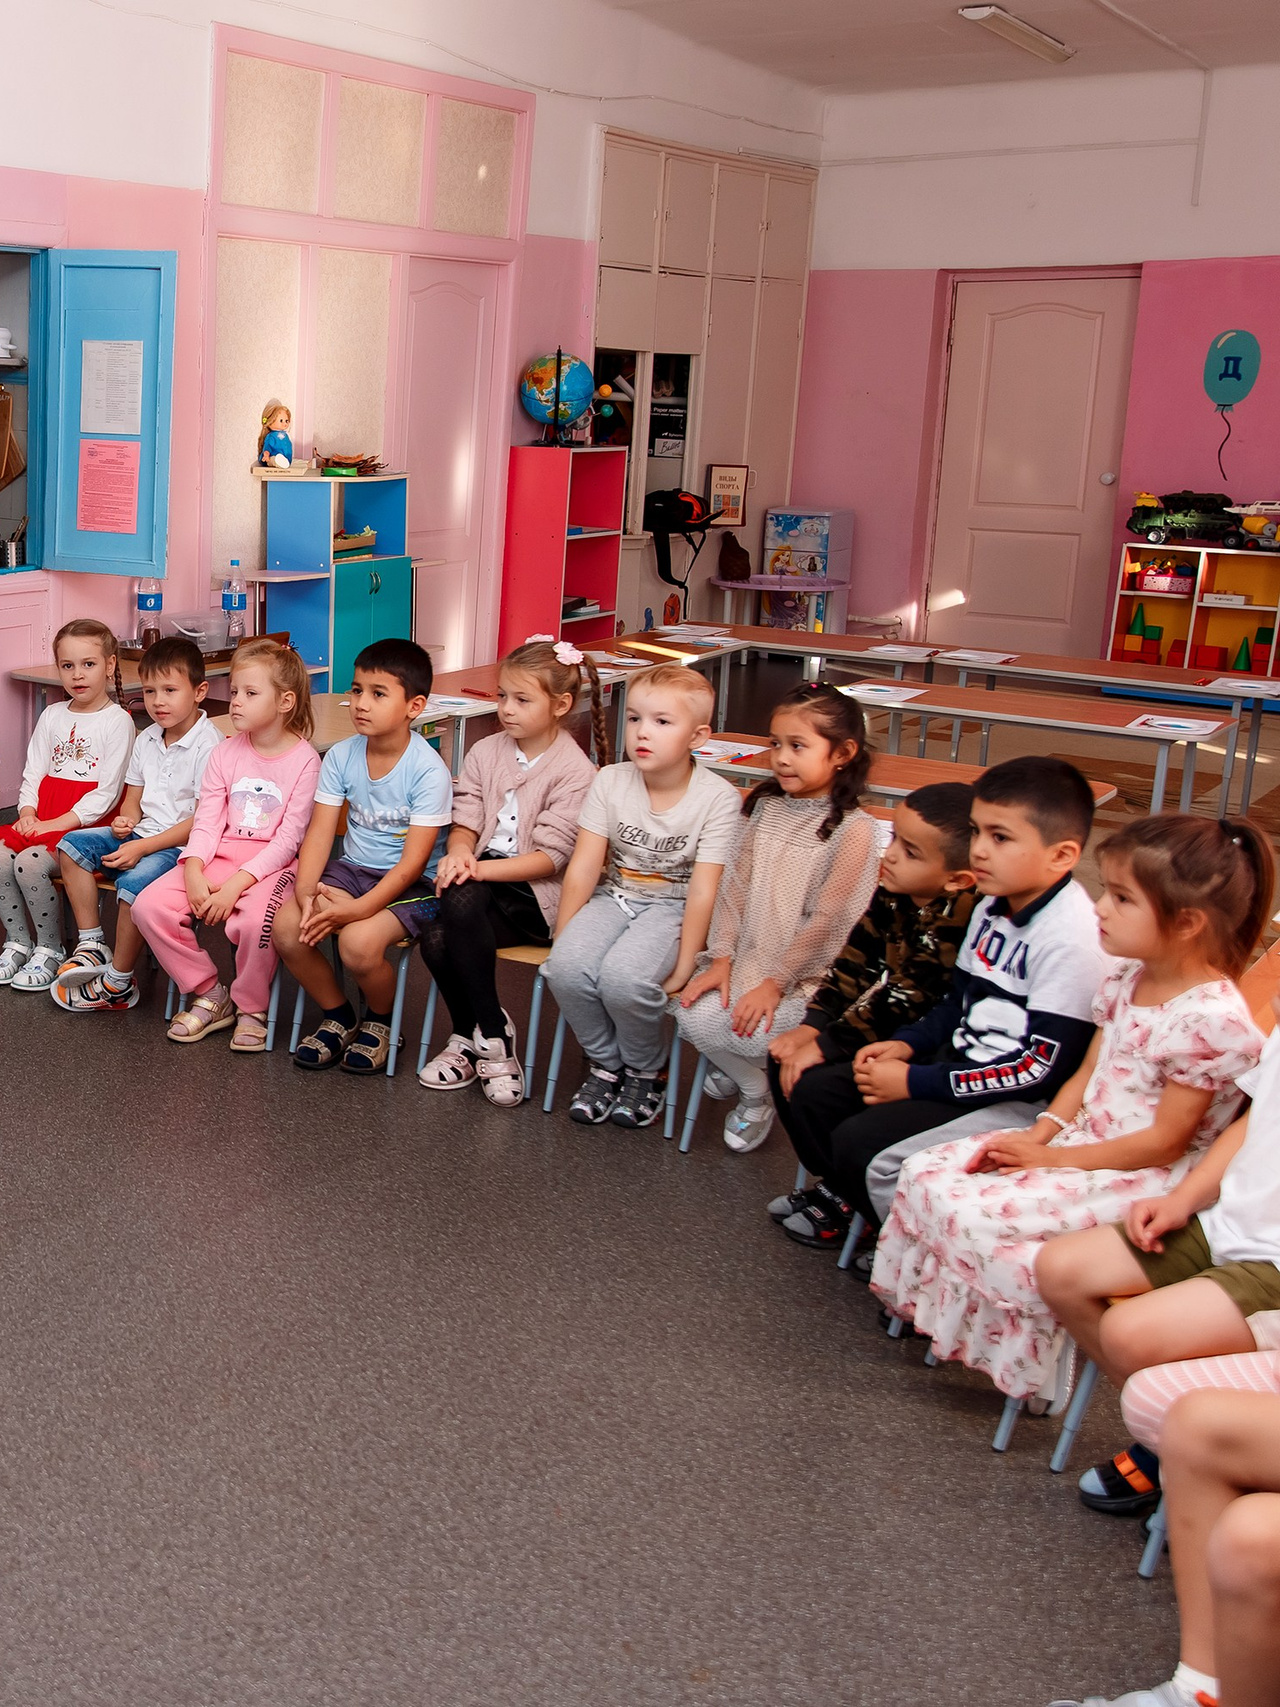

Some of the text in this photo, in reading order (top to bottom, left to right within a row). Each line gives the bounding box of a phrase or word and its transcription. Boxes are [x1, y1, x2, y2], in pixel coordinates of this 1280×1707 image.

[1218, 356, 1243, 382] Д
[455, 719, 461, 730] 2
[616, 821, 689, 851] DESERT VIBES
[258, 869, 296, 950] Almost Famous
[956, 1053, 1045, 1094] JORDAN
